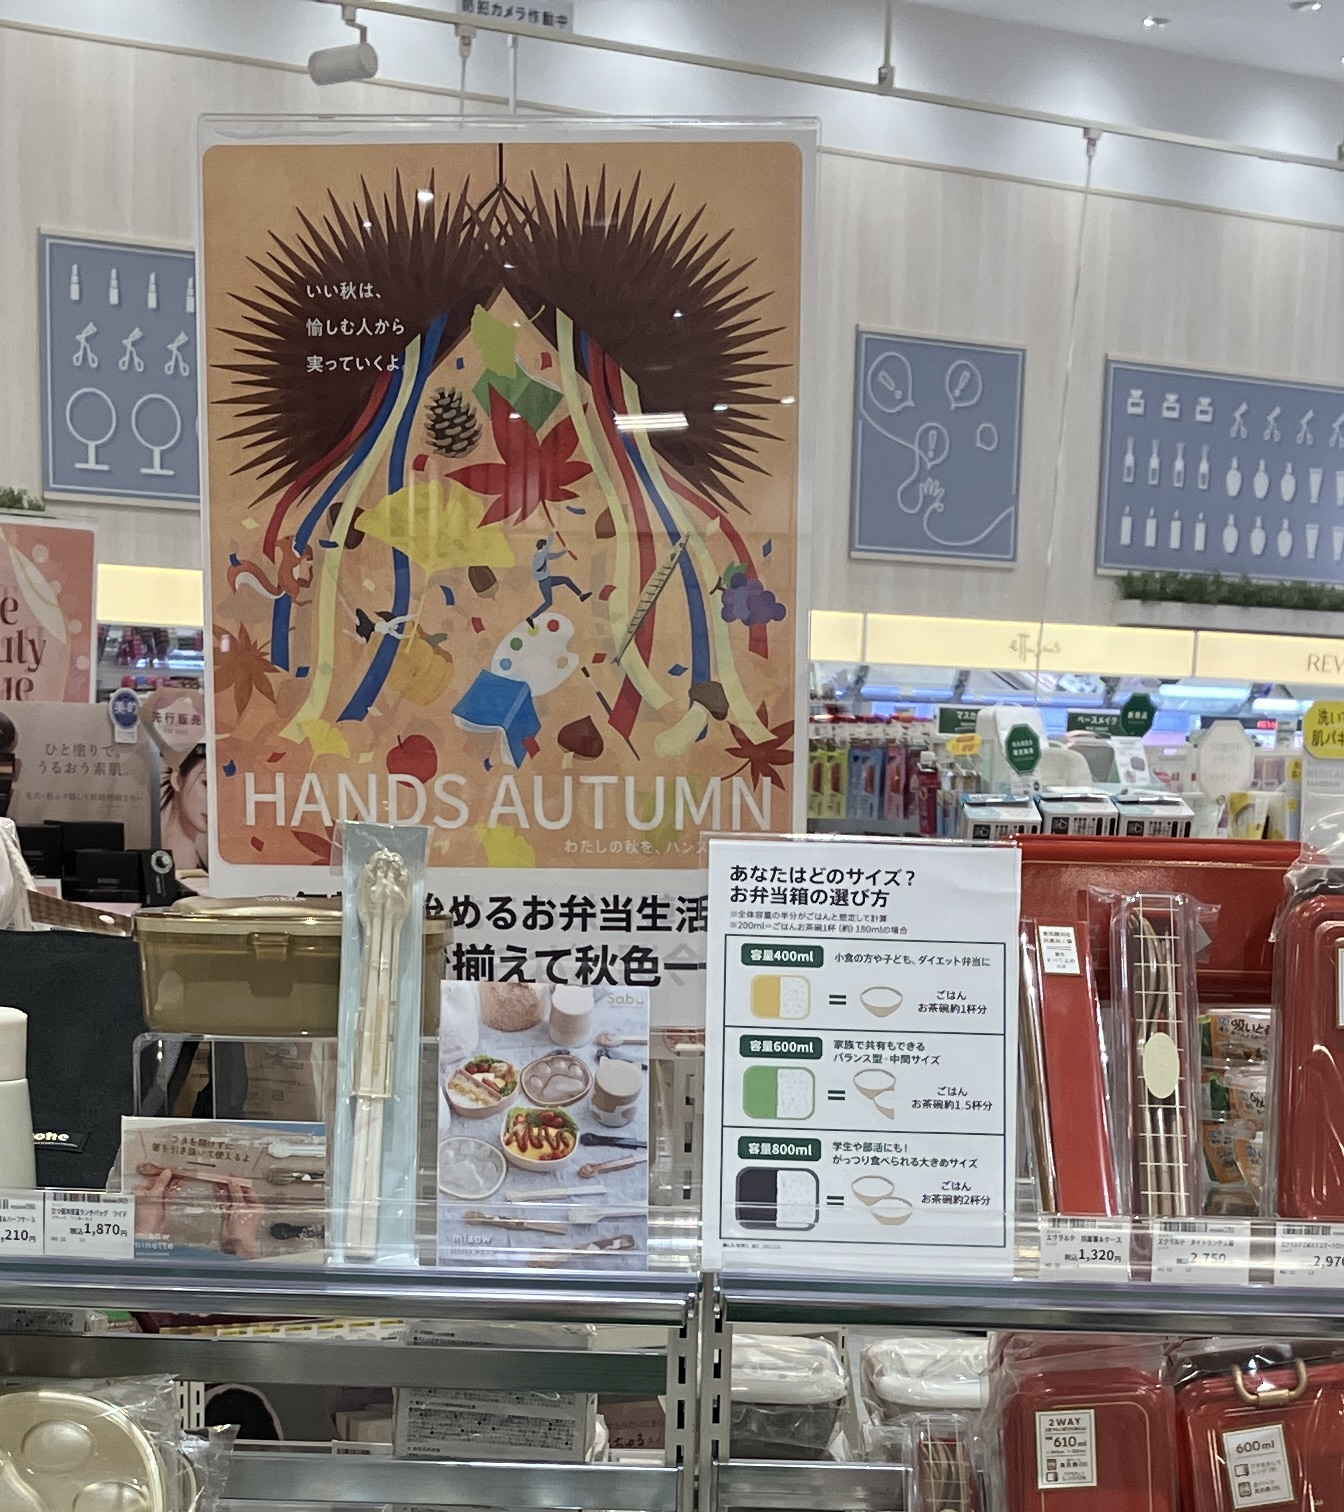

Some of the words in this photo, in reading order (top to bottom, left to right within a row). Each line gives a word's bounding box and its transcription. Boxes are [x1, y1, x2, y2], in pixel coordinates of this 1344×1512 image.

[306, 281, 383, 301] いい秋は、
[306, 318, 405, 337] 愉しむ人から
[244, 771, 471, 830] HANDS
[486, 774, 773, 833] AUTUMN
[729, 864, 916, 889] あなたはどのサイズ？
[729, 886, 890, 908] お弁当箱の選び方
[749, 948, 814, 964] 容量400ml
[935, 990, 968, 1002] ごはん
[749, 1039, 814, 1054] 容量600ml
[935, 1086, 969, 1098] ごはん
[746, 1141, 813, 1158] 容量800ml
[940, 1180, 972, 1192] ごはん
[69, 1222, 128, 1238] 税込1,870円
[1064, 1248, 1122, 1262] 税込1,320円
[1048, 1417, 1082, 1427] 2WAY
[1053, 1434, 1088, 1449] 610ml
[1235, 1439, 1276, 1454] 600ml
